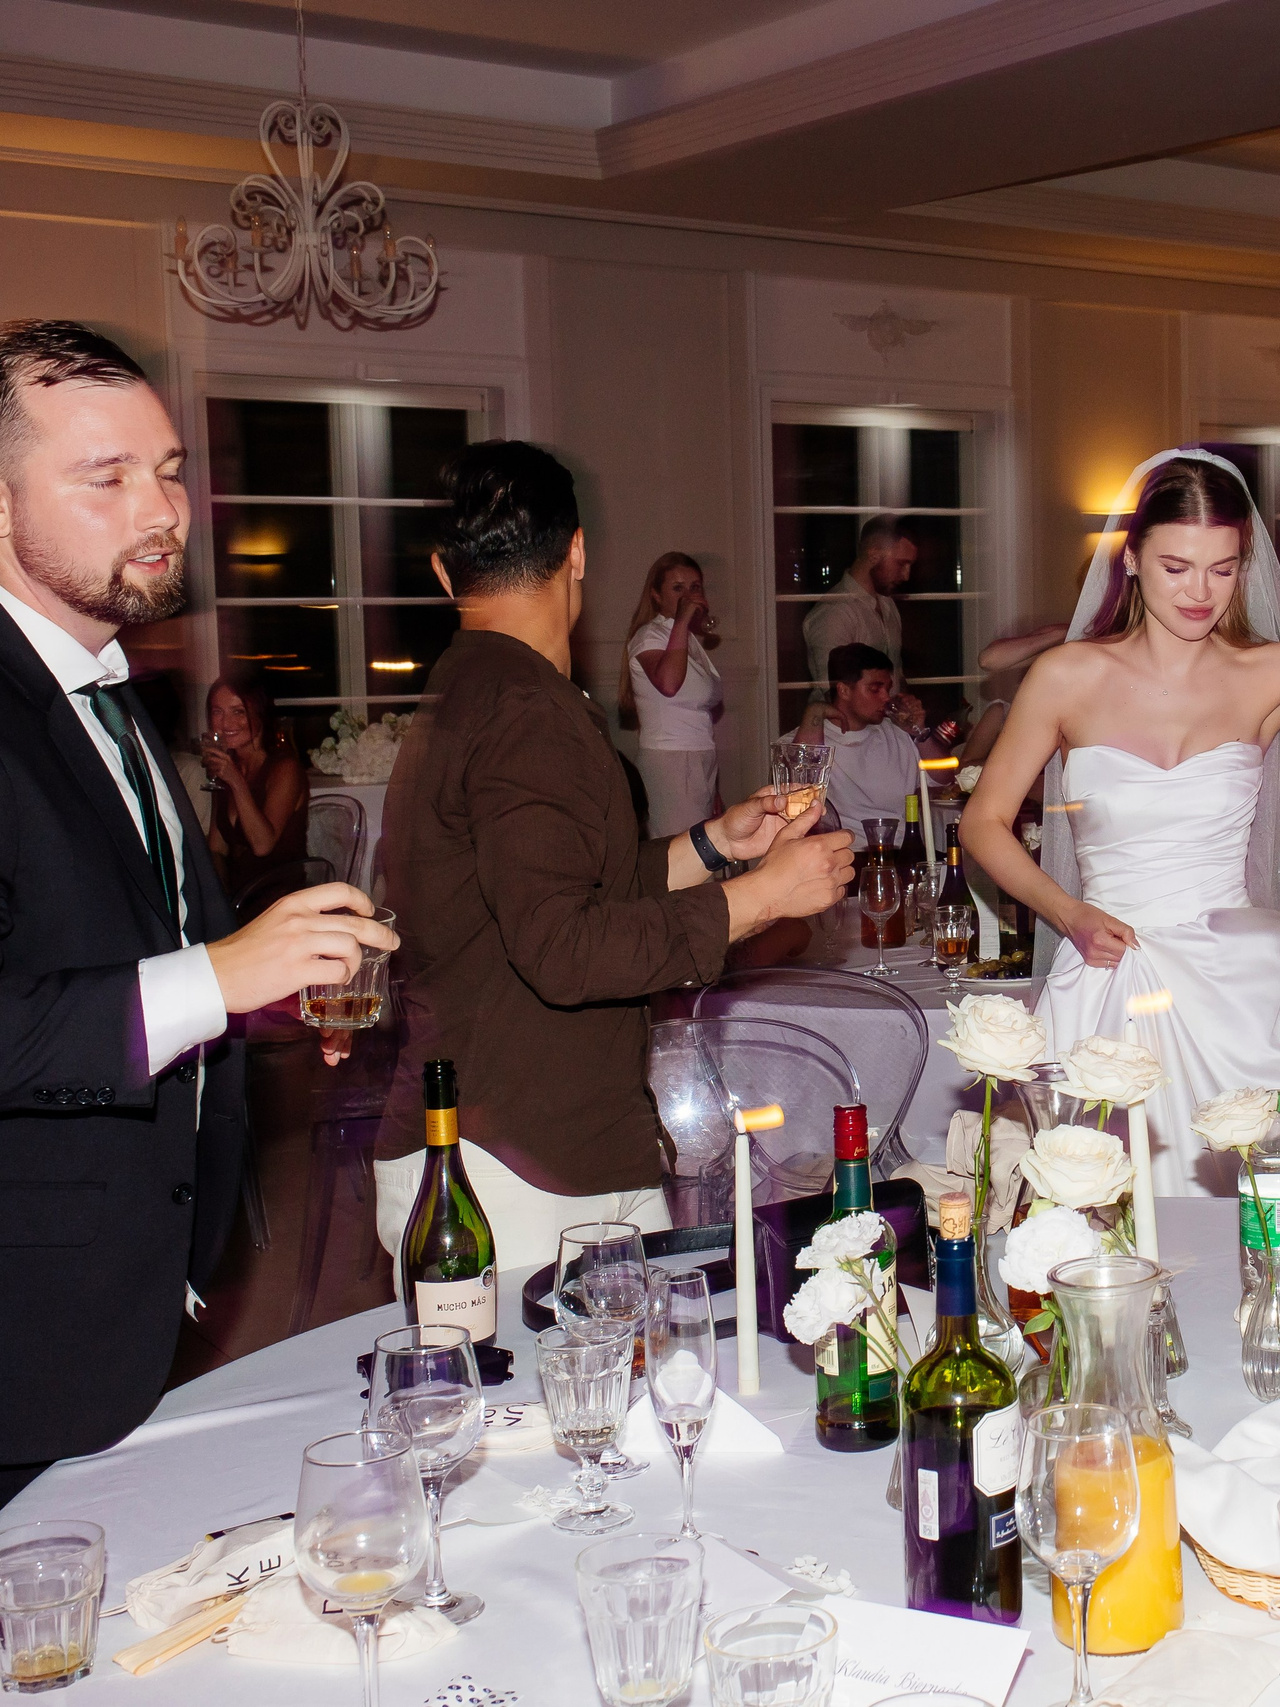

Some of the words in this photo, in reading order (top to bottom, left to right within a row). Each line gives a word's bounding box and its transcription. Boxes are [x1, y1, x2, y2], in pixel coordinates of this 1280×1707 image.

[437, 1301, 467, 1312] MUCHO
[471, 1295, 487, 1308] MÁS
[834, 1658, 891, 1685] Klaudia
